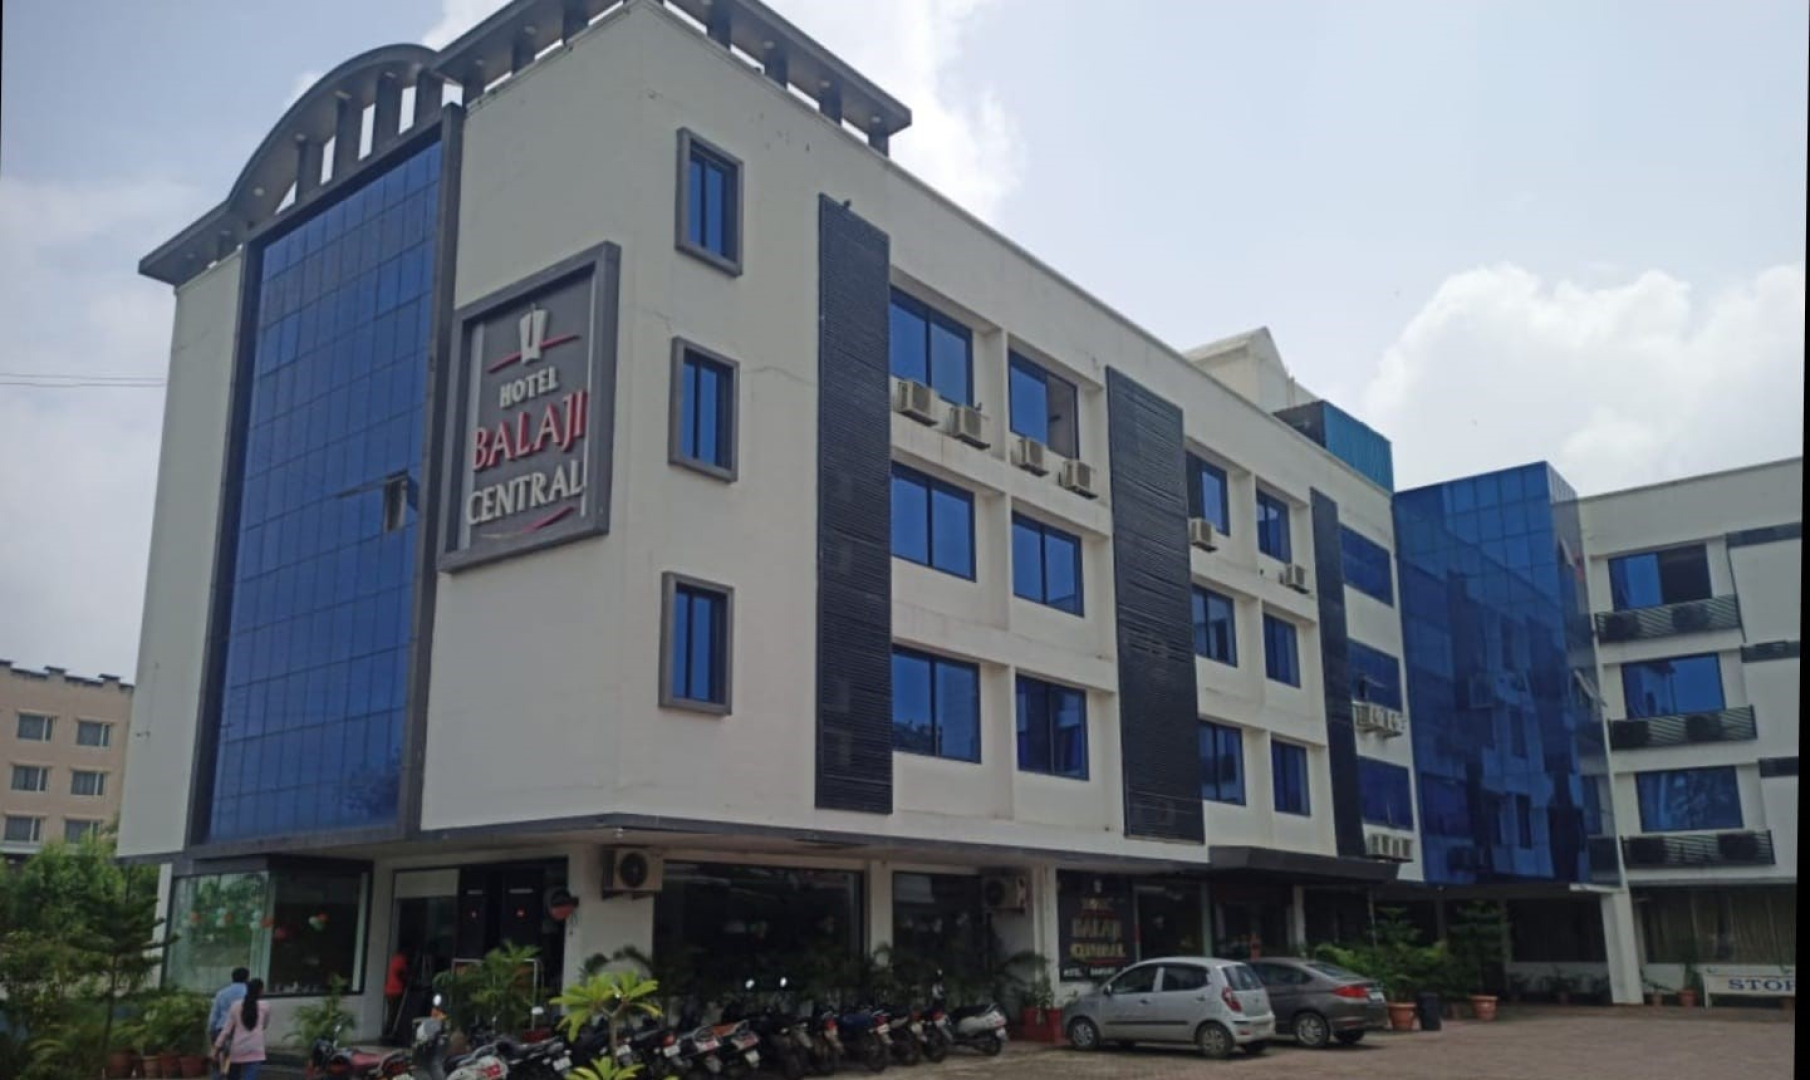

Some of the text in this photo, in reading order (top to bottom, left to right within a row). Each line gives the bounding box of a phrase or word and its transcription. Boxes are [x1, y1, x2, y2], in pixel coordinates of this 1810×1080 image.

[500, 366, 559, 408] HOTEL
[473, 389, 588, 472] BALAJI
[466, 459, 586, 526] CENTRAL
